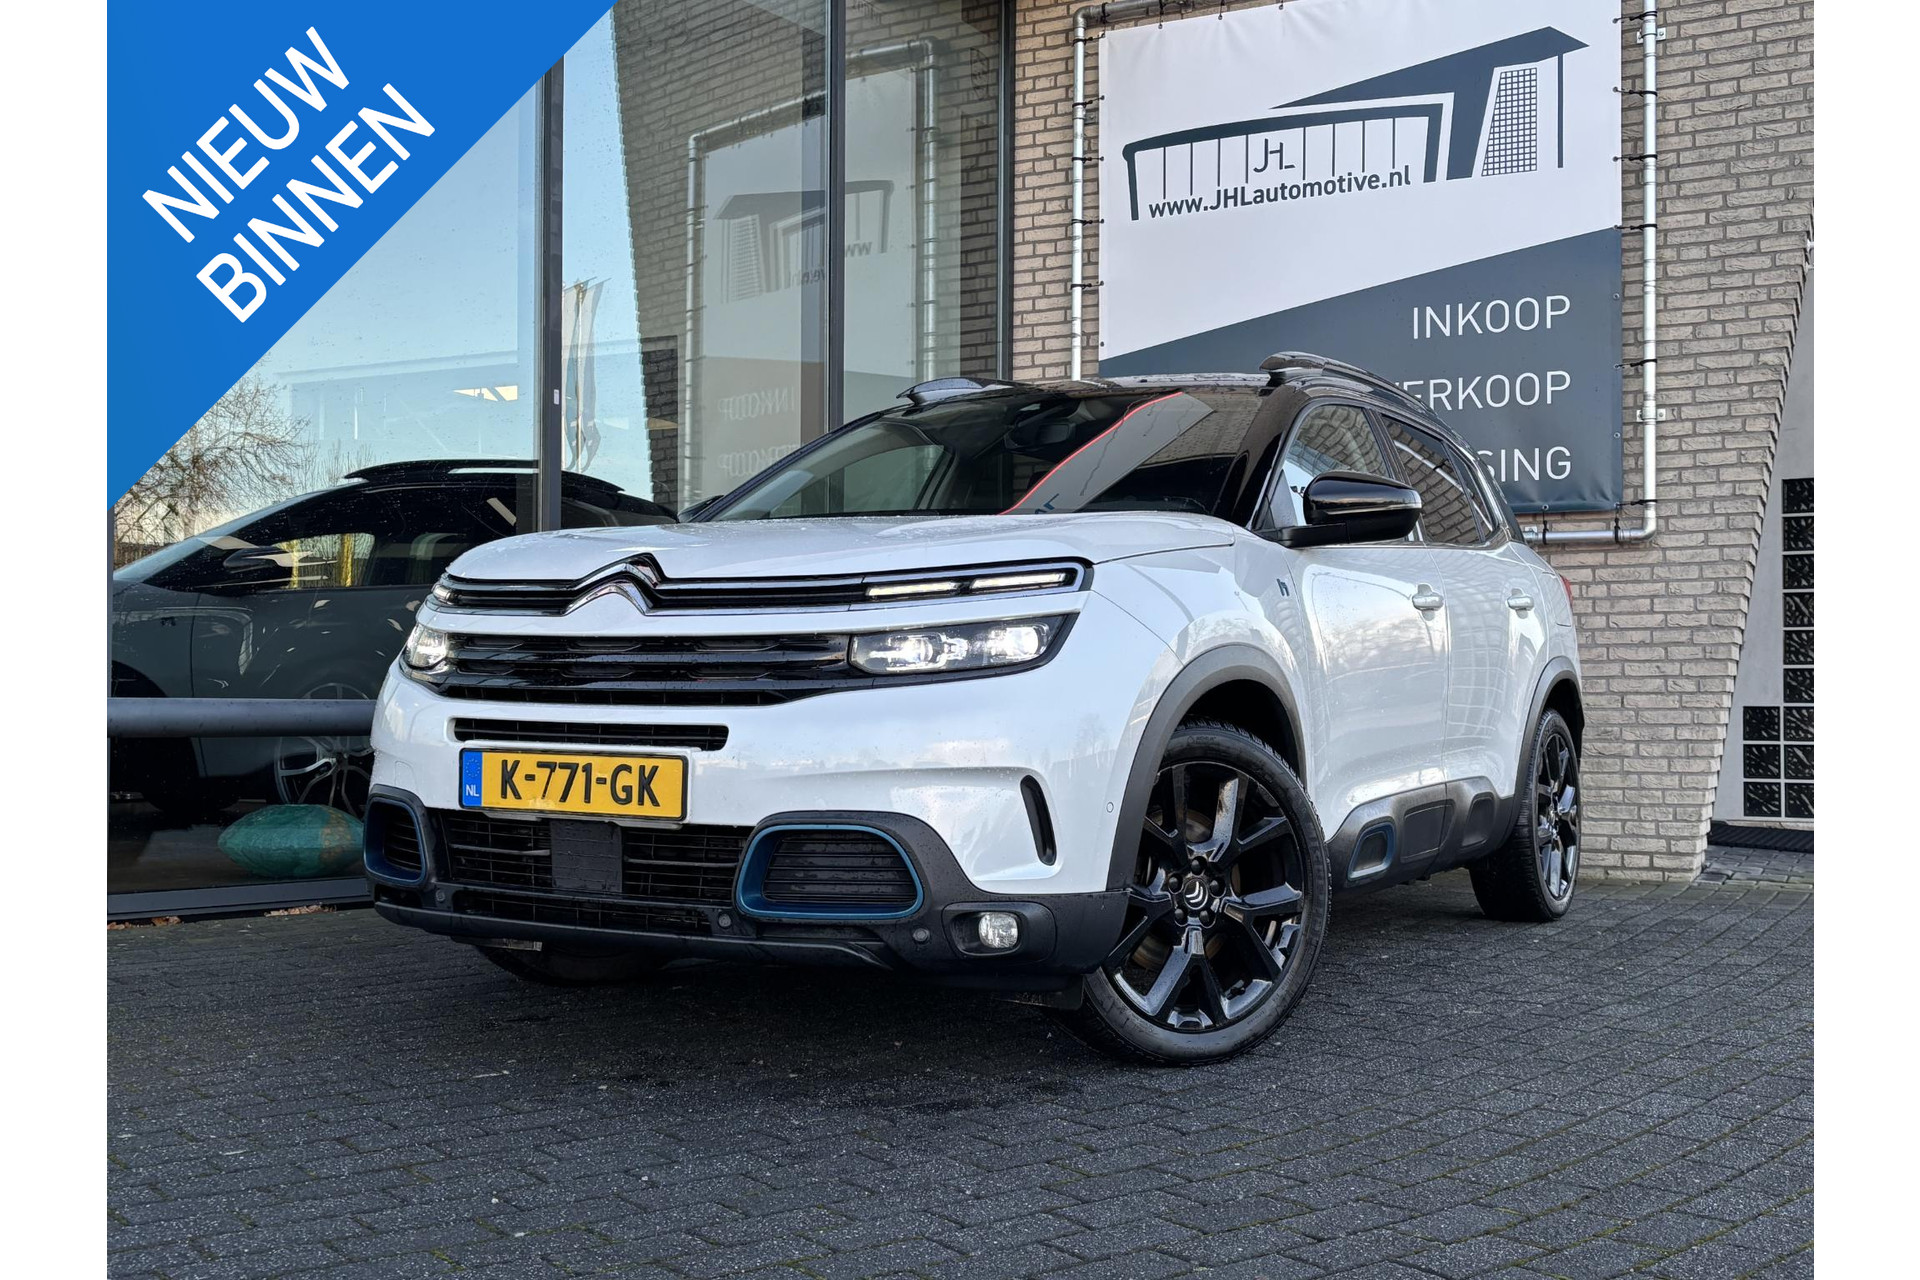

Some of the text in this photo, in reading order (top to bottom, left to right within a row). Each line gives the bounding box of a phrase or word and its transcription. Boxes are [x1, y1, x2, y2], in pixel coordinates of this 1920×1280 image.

[1149, 165, 1411, 218] www.JHLautomotive.nl
[1413, 295, 1570, 339] INKOOP
[1396, 370, 1571, 411] RKOOP
[466, 784, 480, 797] NL
[501, 759, 661, 807] K-771-GK
